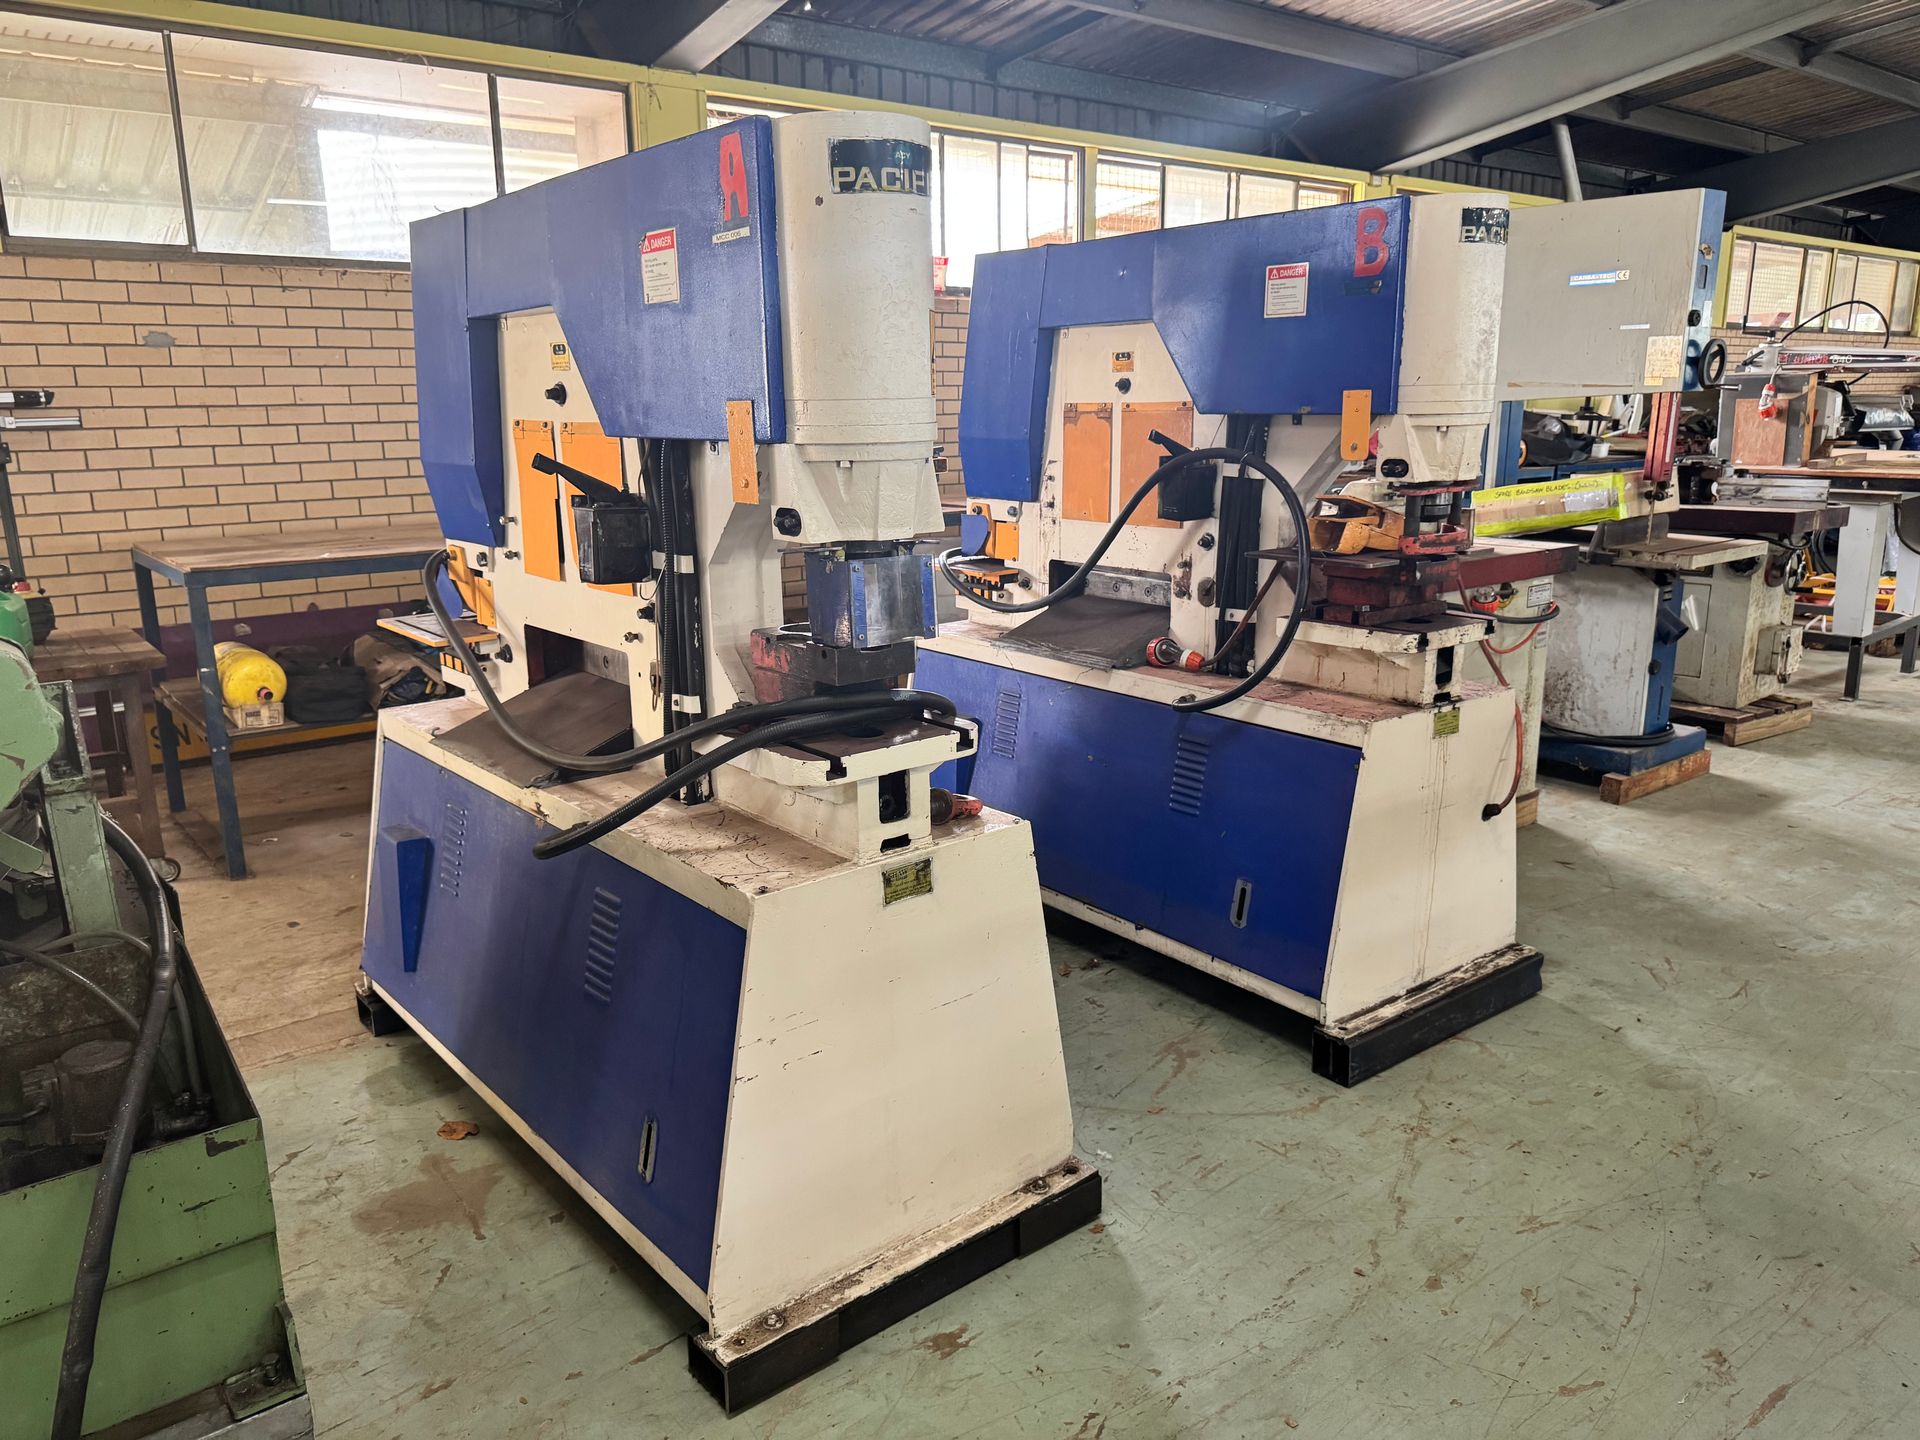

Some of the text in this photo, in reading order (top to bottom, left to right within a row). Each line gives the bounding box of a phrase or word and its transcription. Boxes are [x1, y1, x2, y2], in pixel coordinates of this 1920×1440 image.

[719, 131, 749, 222] A
[650, 235, 672, 249] DANGER
[1353, 207, 1389, 278] B
[1279, 267, 1303, 277] DANGER
